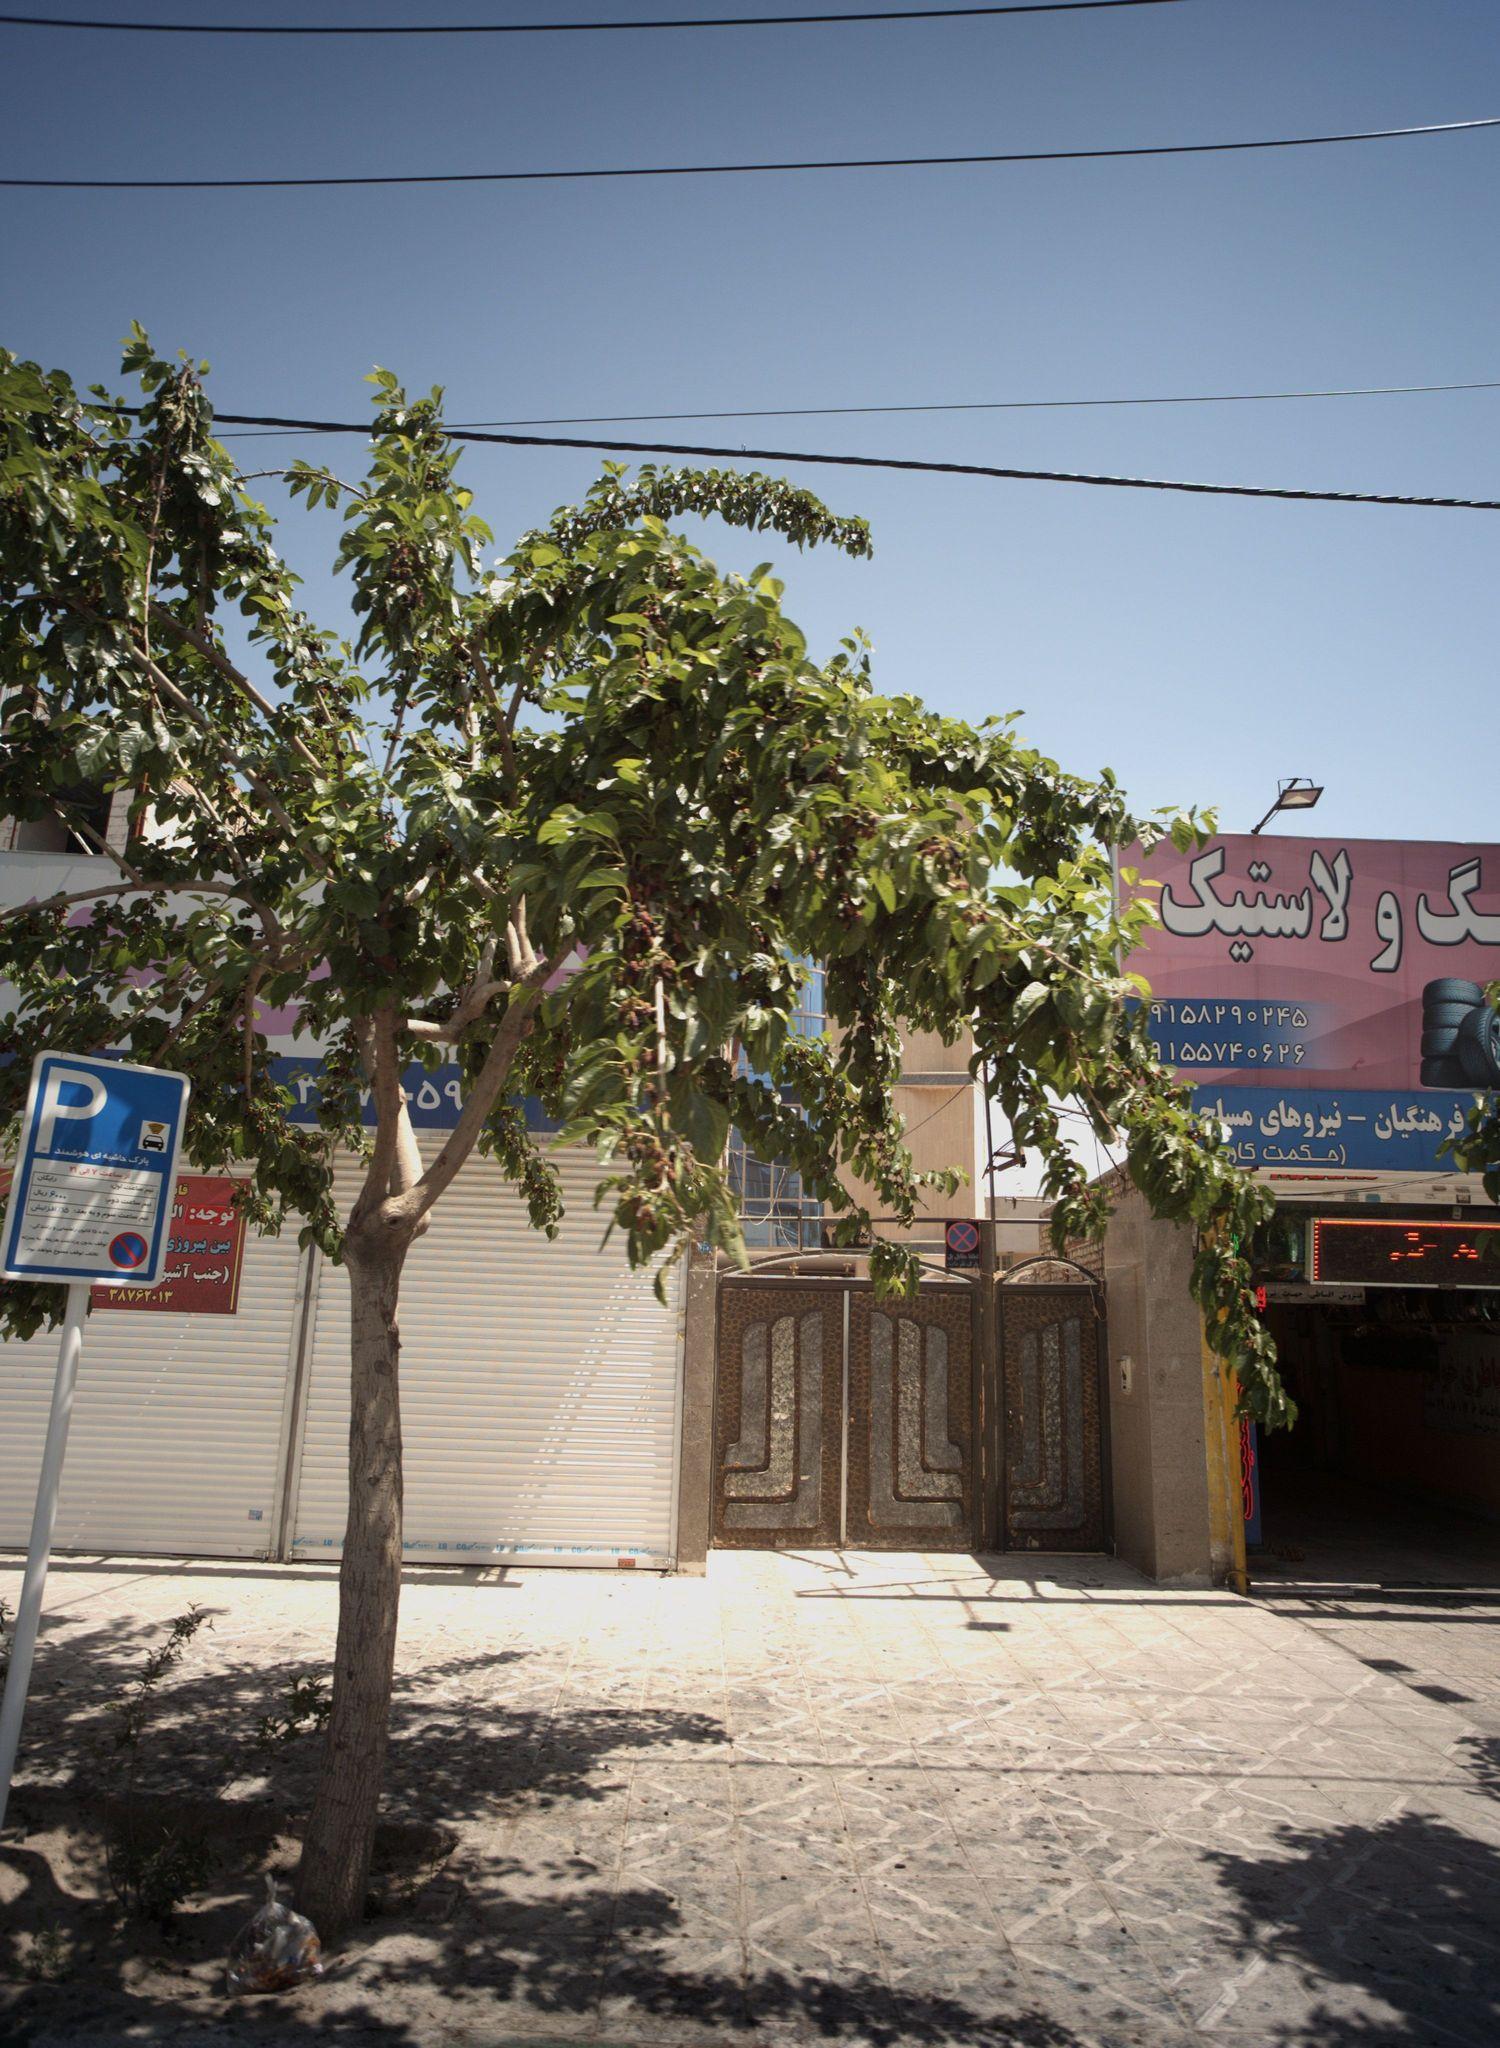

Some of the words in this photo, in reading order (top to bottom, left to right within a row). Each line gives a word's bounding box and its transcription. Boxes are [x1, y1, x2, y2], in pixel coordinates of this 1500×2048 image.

[1160, 846, 1352, 963] لاستیک
[1370, 891, 1403, 972] و
[35, 1066, 108, 1154] P
[1259, 1099, 1342, 1138] نیروهای
[1374, 1102, 1465, 1140] فرهنگیان
[54, 1147, 90, 1159] هوشمند
[103, 1152, 127, 1163] حاشیه
[129, 1155, 150, 1166] پارک
[189, 1206, 235, 1226] توجه:
[209, 1238, 231, 1254] بین
